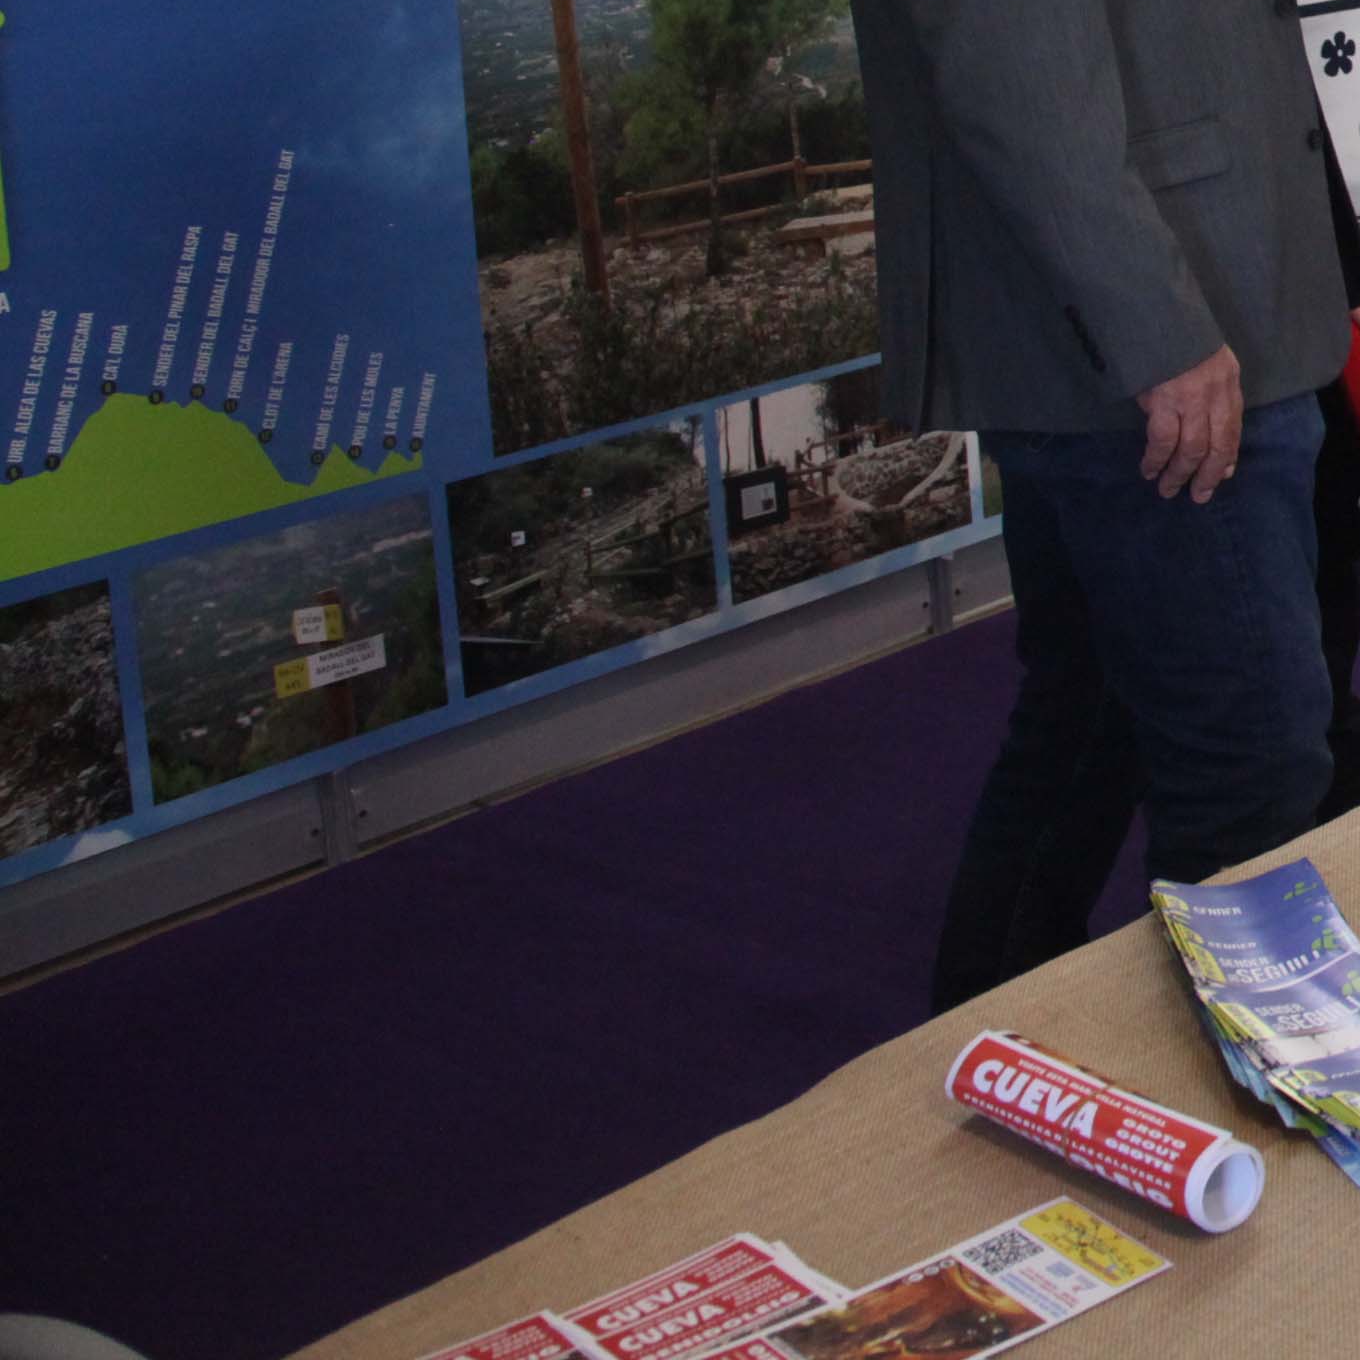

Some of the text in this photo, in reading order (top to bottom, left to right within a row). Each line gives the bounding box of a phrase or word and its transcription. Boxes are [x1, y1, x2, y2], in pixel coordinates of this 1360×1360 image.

[273, 173, 290, 193] DEL
[264, 196, 285, 234] BADALL
[259, 237, 276, 257] DEL
[152, 225, 202, 387] SENDER DEL PINAR DEL RASPA
[192, 231, 240, 385] SENDER DEL BADALL DEL GAT
[33, 310, 57, 353] CUEVAS
[27, 356, 47, 377] LAS
[233, 354, 250, 369] DE
[22, 380, 40, 394] DE
[47, 312, 94, 454] BARRANC DE LA BUSCANA
[228, 370, 246, 399] FORN
[267, 387, 283, 401] DE
[323, 385, 338, 405] LES
[352, 352, 384, 446] POU DE LES MULES
[14, 397, 37, 433] ALDEA
[262, 403, 280, 429] CLOT
[319, 406, 334, 420] DE
[384, 387, 405, 435] LA PENYA
[412, 372, 438, 437] AJUNTAMENT
[973, 1059, 1098, 1139] CUEVA
[1116, 1129, 1180, 1161] GROUT
[1122, 1118, 1187, 1149] GROTO
[1072, 1140, 1095, 1156] LAS
[1097, 1151, 1172, 1189] CALAVERAS
[1104, 1137, 1175, 1173] GROTTE
[597, 1280, 700, 1331] CUEVA
[618, 1303, 726, 1352] CUEVA
